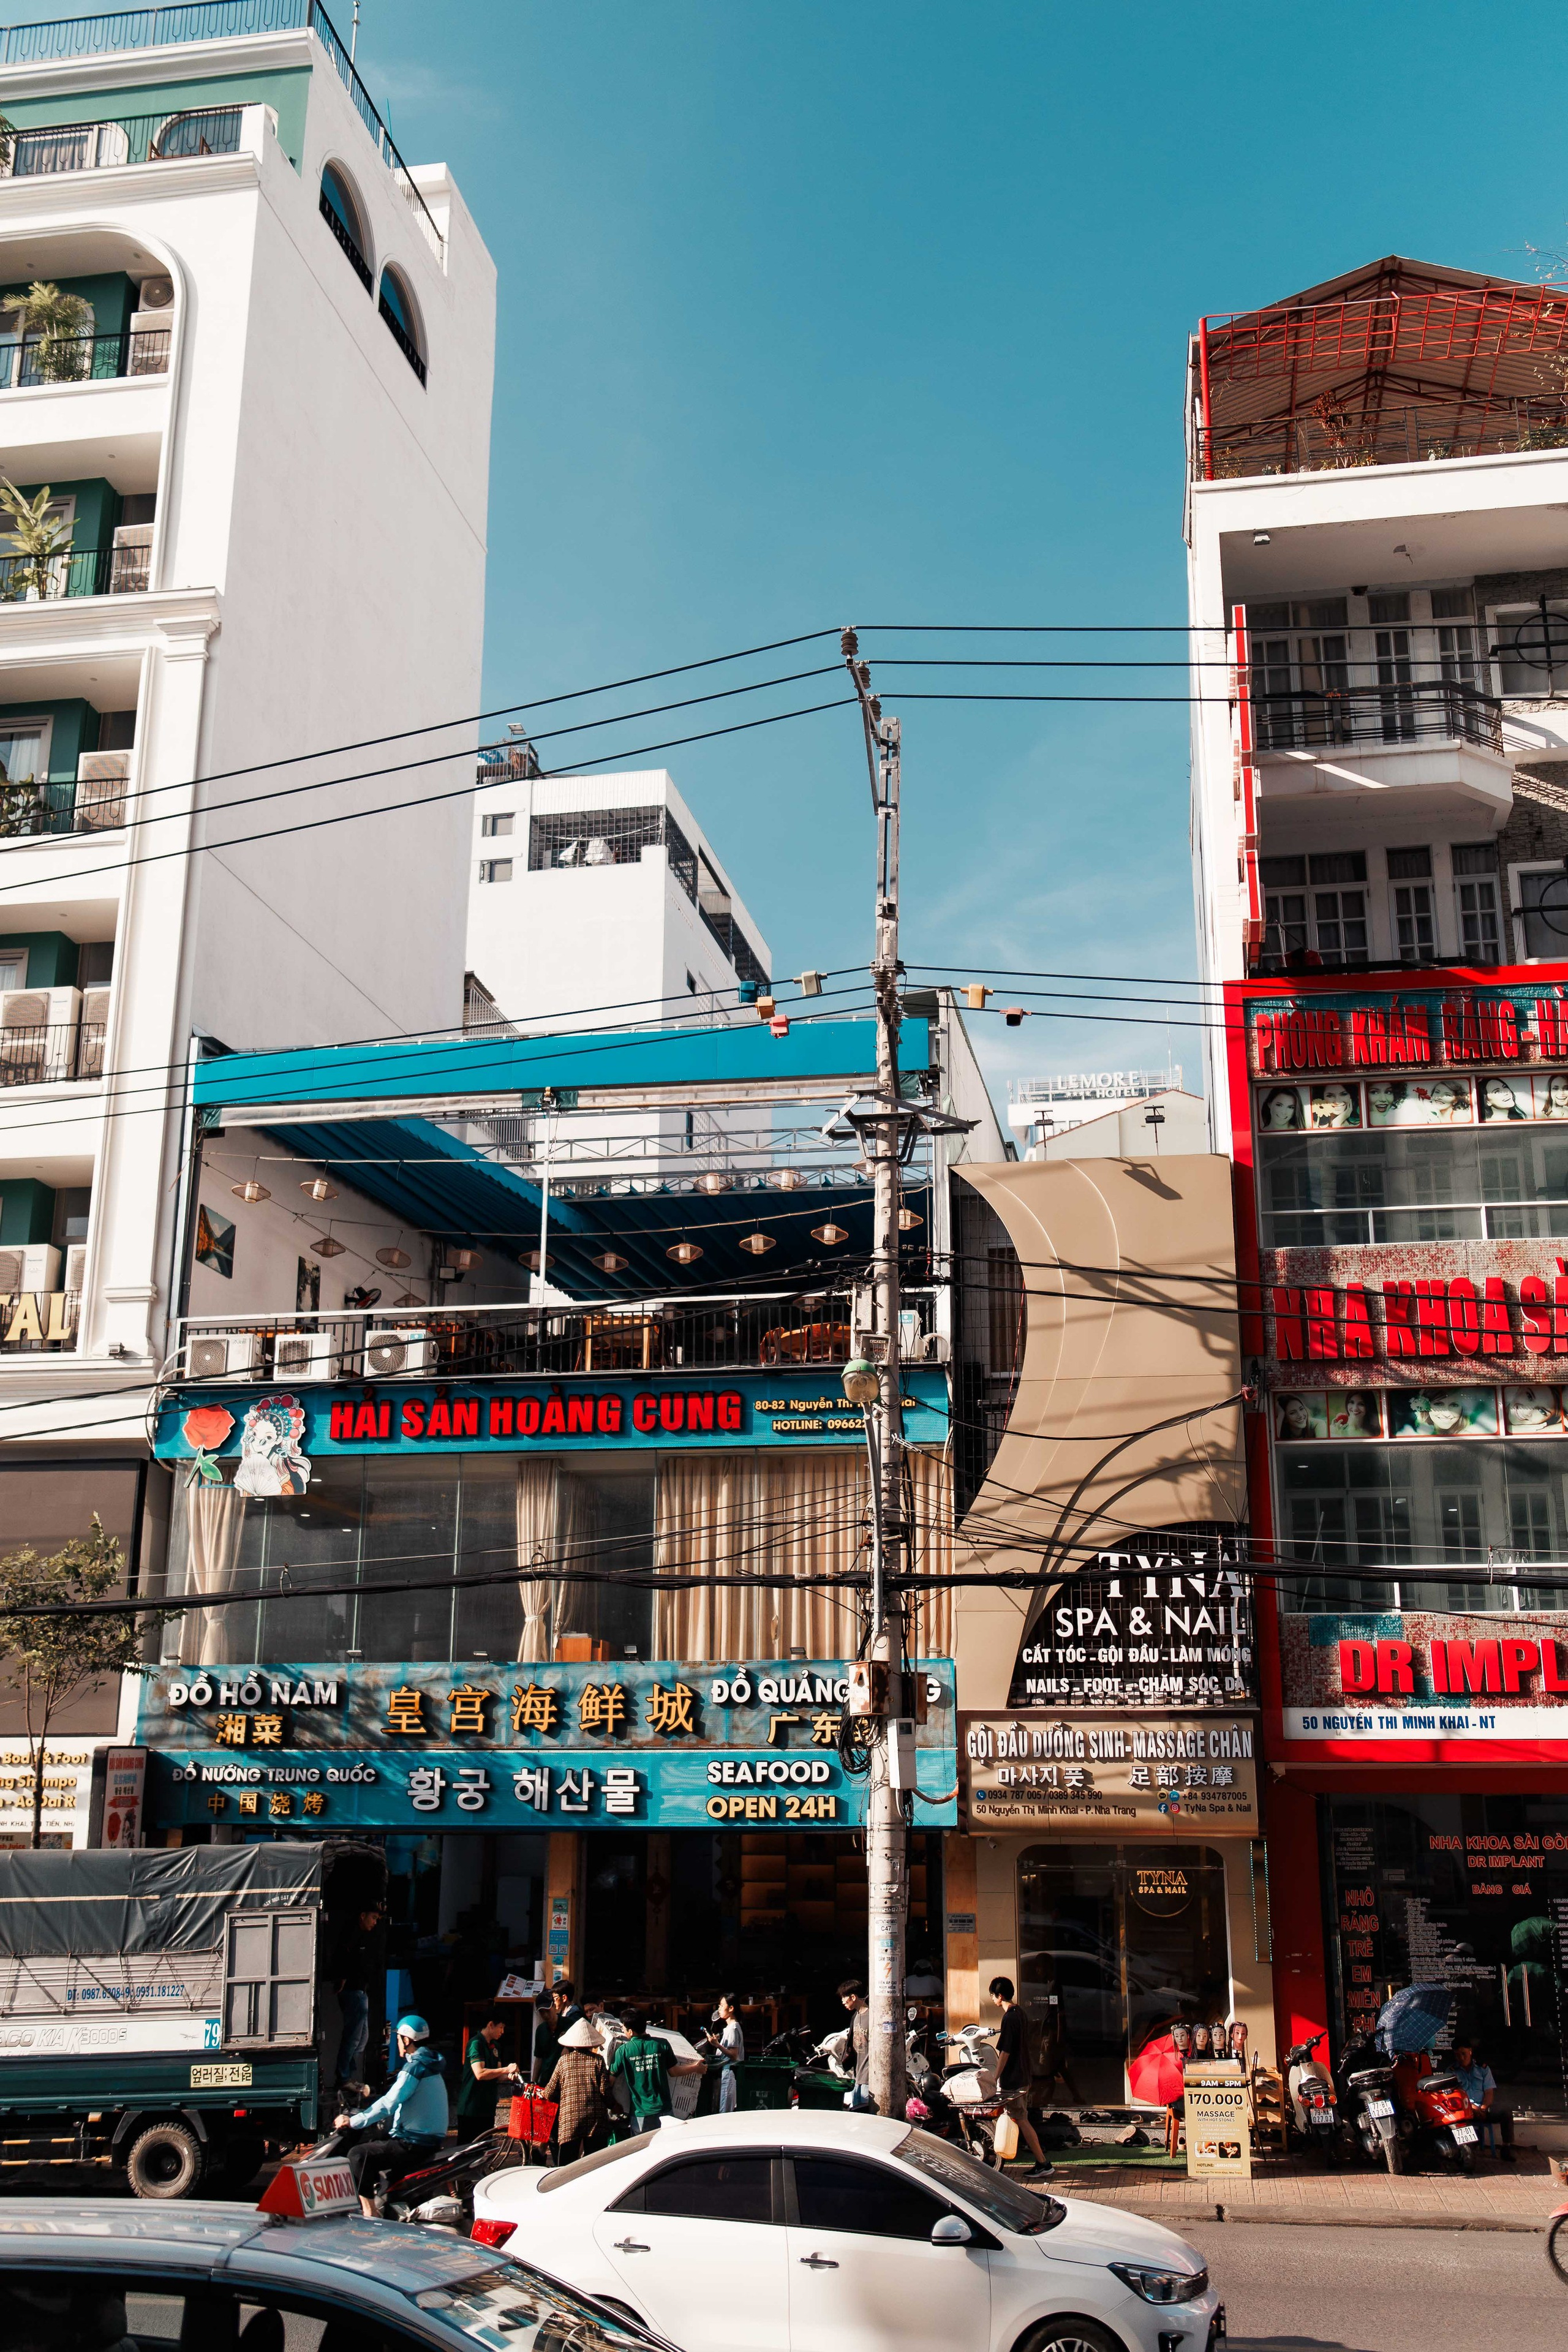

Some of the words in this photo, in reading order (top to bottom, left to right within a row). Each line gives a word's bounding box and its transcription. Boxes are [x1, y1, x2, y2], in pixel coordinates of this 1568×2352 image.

[1256, 1000, 1341, 1069] PHÒNG
[1351, 995, 1431, 1065] KHÁM
[1058, 1071, 1139, 1090] LEMORE
[1096, 1088, 1139, 1098] HOTEL
[0, 1292, 71, 1341] AL
[1272, 1283, 1373, 1360] NHA
[1382, 1277, 1513, 1356] KHOA
[330, 1387, 391, 1439] HẢI
[401, 1386, 480, 1438] SẢN
[489, 1386, 622, 1435] HOÀNG
[633, 1390, 742, 1431] CUNG
[755, 1400, 785, 1410] 80-82
[790, 1396, 832, 1412] Nguyễn
[773, 1420, 823, 1430] HOTLINE:
[1099, 1552, 1246, 1597] TYNA
[1056, 1607, 1118, 1637] SPA
[1129, 1605, 1153, 1636] &
[1166, 1605, 1246, 1635] NAIL
[1022, 1643, 1050, 1664] CẮT
[1056, 1644, 1086, 1662] TÓC
[1098, 1645, 1123, 1665] GỘI
[1128, 1643, 1159, 1663] ĐẦU
[1170, 1645, 1202, 1662] LÀM
[1207, 1645, 1251, 1662] MÓNG
[1338, 1640, 1414, 1692] DR
[168, 1670, 213, 1706] ĐỒ
[221, 1670, 262, 1705] HỒ
[271, 1681, 337, 1705] NAM
[711, 1665, 750, 1703] ĐỒ
[758, 1669, 850, 1703] QUẢNG
[1026, 1678, 1069, 1693] NAILS
[1084, 1677, 1121, 1692] FOOT
[1139, 1674, 1183, 1692] CHĂM
[1189, 1673, 1219, 1692] SÓC
[1226, 1677, 1245, 1691] DA
[381, 1682, 693, 1734] 皇宫海鲜城
[215, 1713, 283, 1744] 湘菜
[1303, 1716, 1317, 1730] 50
[1323, 1712, 1373, 1730] NGUYỄN
[1403, 1716, 1435, 1729] MINH
[1439, 1716, 1469, 1729] KHAI
[1479, 1716, 1495, 1728] NT
[967, 1724, 993, 1765] GỘI
[997, 1721, 1028, 1758] ĐẦU
[1033, 1721, 1085, 1758] DƯỠNG
[1209, 1724, 1252, 1758] CHÂN
[2, 1752, 38, 1764] Bod
[54, 1752, 87, 1764] Foot
[173, 1761, 197, 1781] ĐỒ
[202, 1763, 260, 1782] NƯỚNG
[268, 1768, 320, 1782] TRUNG
[326, 1763, 375, 1782] QUỐC
[707, 1761, 829, 1784] SEAFOOD
[998, 1765, 1057, 1786] 마사지
[1128, 1765, 1233, 1786] 足部按摩
[407, 1767, 490, 1811] 황궁
[513, 1767, 639, 1813] 해산물
[988, 1790, 1007, 1800] 0934
[1011, 1790, 1025, 1800] 787
[1027, 1790, 1041, 1800] 005
[1049, 1790, 1068, 1800] 0389
[1071, 1790, 1085, 1800] 345
[1088, 1790, 1102, 1800] 990
[1182, 1792, 1197, 1801] +84
[1201, 1792, 1247, 1801] 934787005
[208, 1792, 324, 1815] 中国烧烤
[706, 1796, 776, 1819] OPEN
[785, 1796, 835, 1819] 24H
[976, 1805, 986, 1814] 50
[989, 1804, 1020, 1816] Nguyễn
[1022, 1805, 1035, 1815] Thị
[1038, 1805, 1057, 1814] Minh
[1060, 1805, 1079, 1814] Khai
[1112, 1806, 1136, 1817] Trang
[1185, 1804, 1206, 1814] TyNa
[1208, 1804, 1225, 1814] Spa
[1430, 1836, 1463, 1850] NHA
[1466, 1836, 1510, 1850] KHOA
[1513, 1833, 1539, 1850] SÀI
[1542, 1833, 1568, 1850] GÒ
[1468, 1856, 1487, 1868] DR
[1488, 1856, 1545, 1868] IMPLANT
[1137, 1871, 1188, 1885] TYNA
[1472, 1882, 1503, 1894] BẢNG
[1512, 1882, 1532, 1894] GIÁ
[1345, 1886, 1374, 1906] NHỔ
[1341, 1910, 1379, 1932] RĂNG
[1347, 1937, 1374, 1957] TRẺ
[1352, 1965, 1372, 1983] EM
[1348, 1988, 1381, 2008] MIỄN
[1354, 2012, 1376, 2033] PHÍ
[37, 2029, 65, 2047] KIA
[205, 2023, 220, 2047] 79
[1188, 2094, 1243, 2105] 170.000
